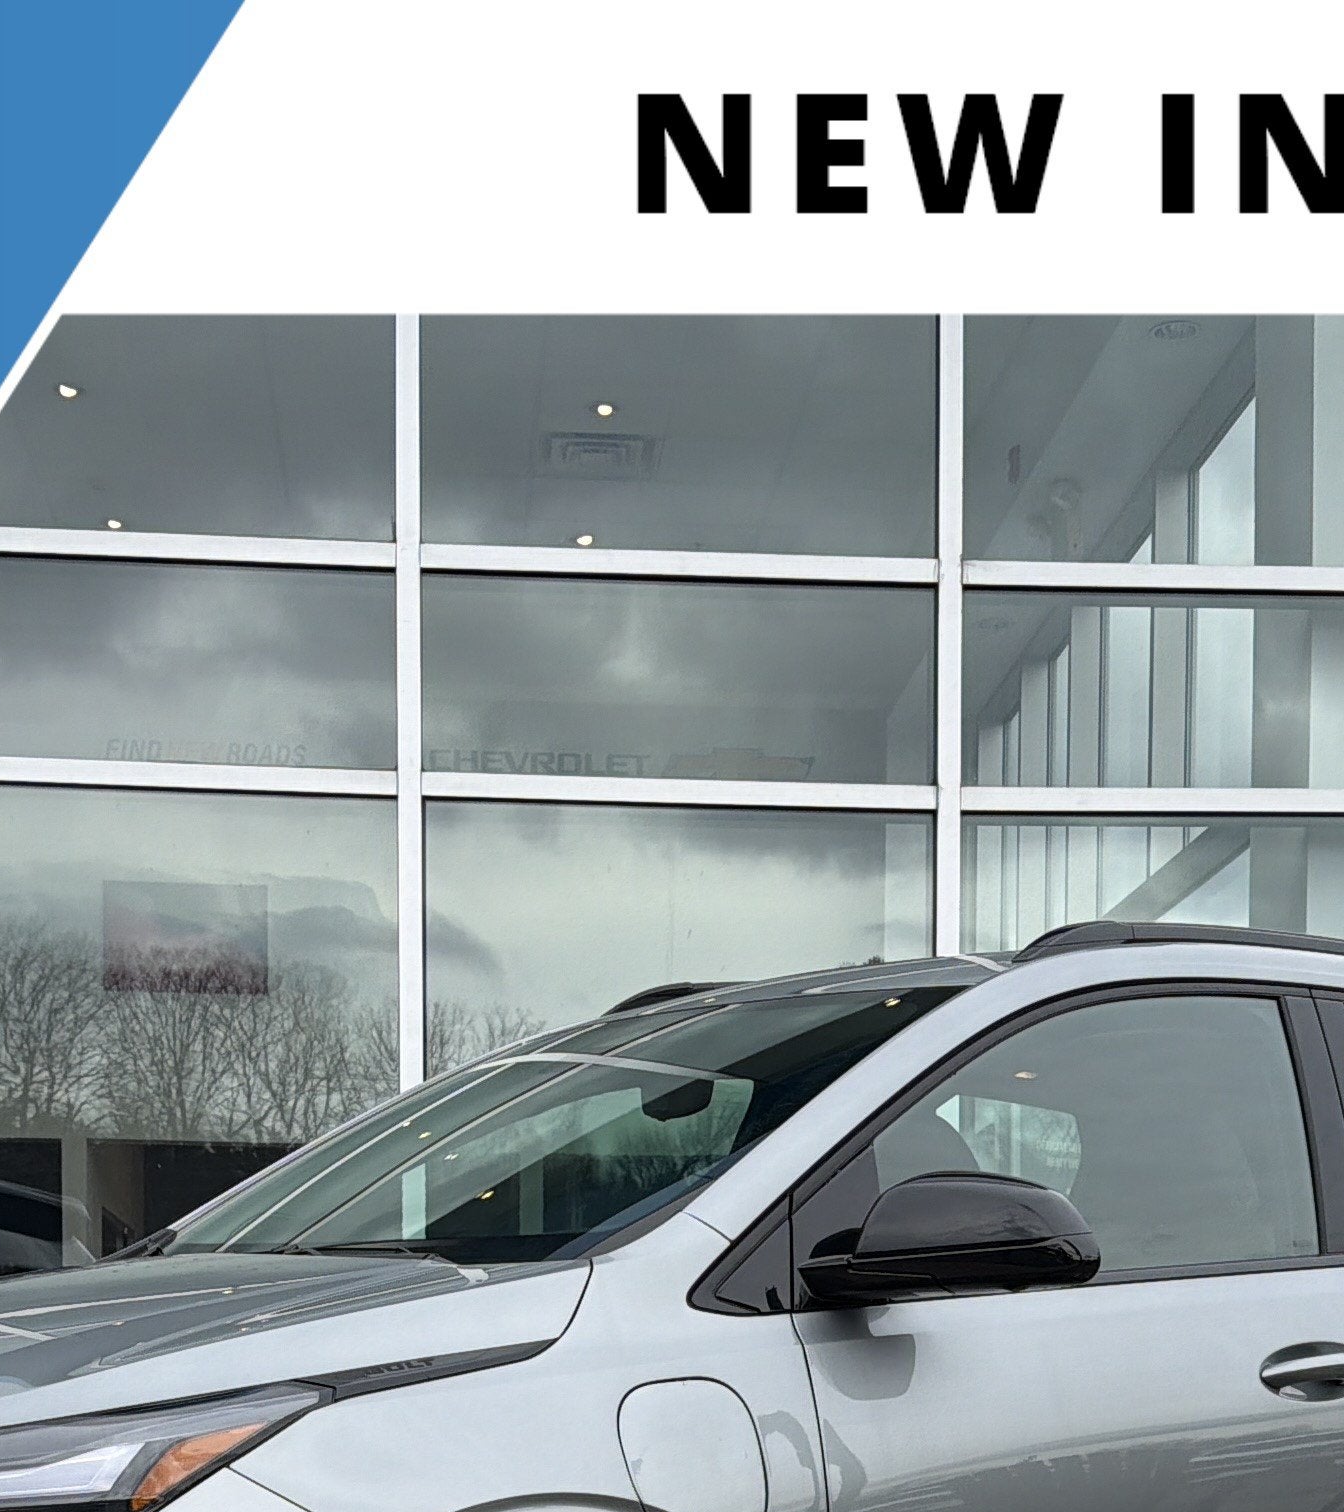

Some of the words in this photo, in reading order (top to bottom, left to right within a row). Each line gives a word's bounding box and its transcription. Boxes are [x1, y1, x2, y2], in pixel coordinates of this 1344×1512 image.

[106, 738, 163, 763] FIND
[226, 741, 307, 768] ROADS
[429, 749, 651, 778] CHEVROLET
